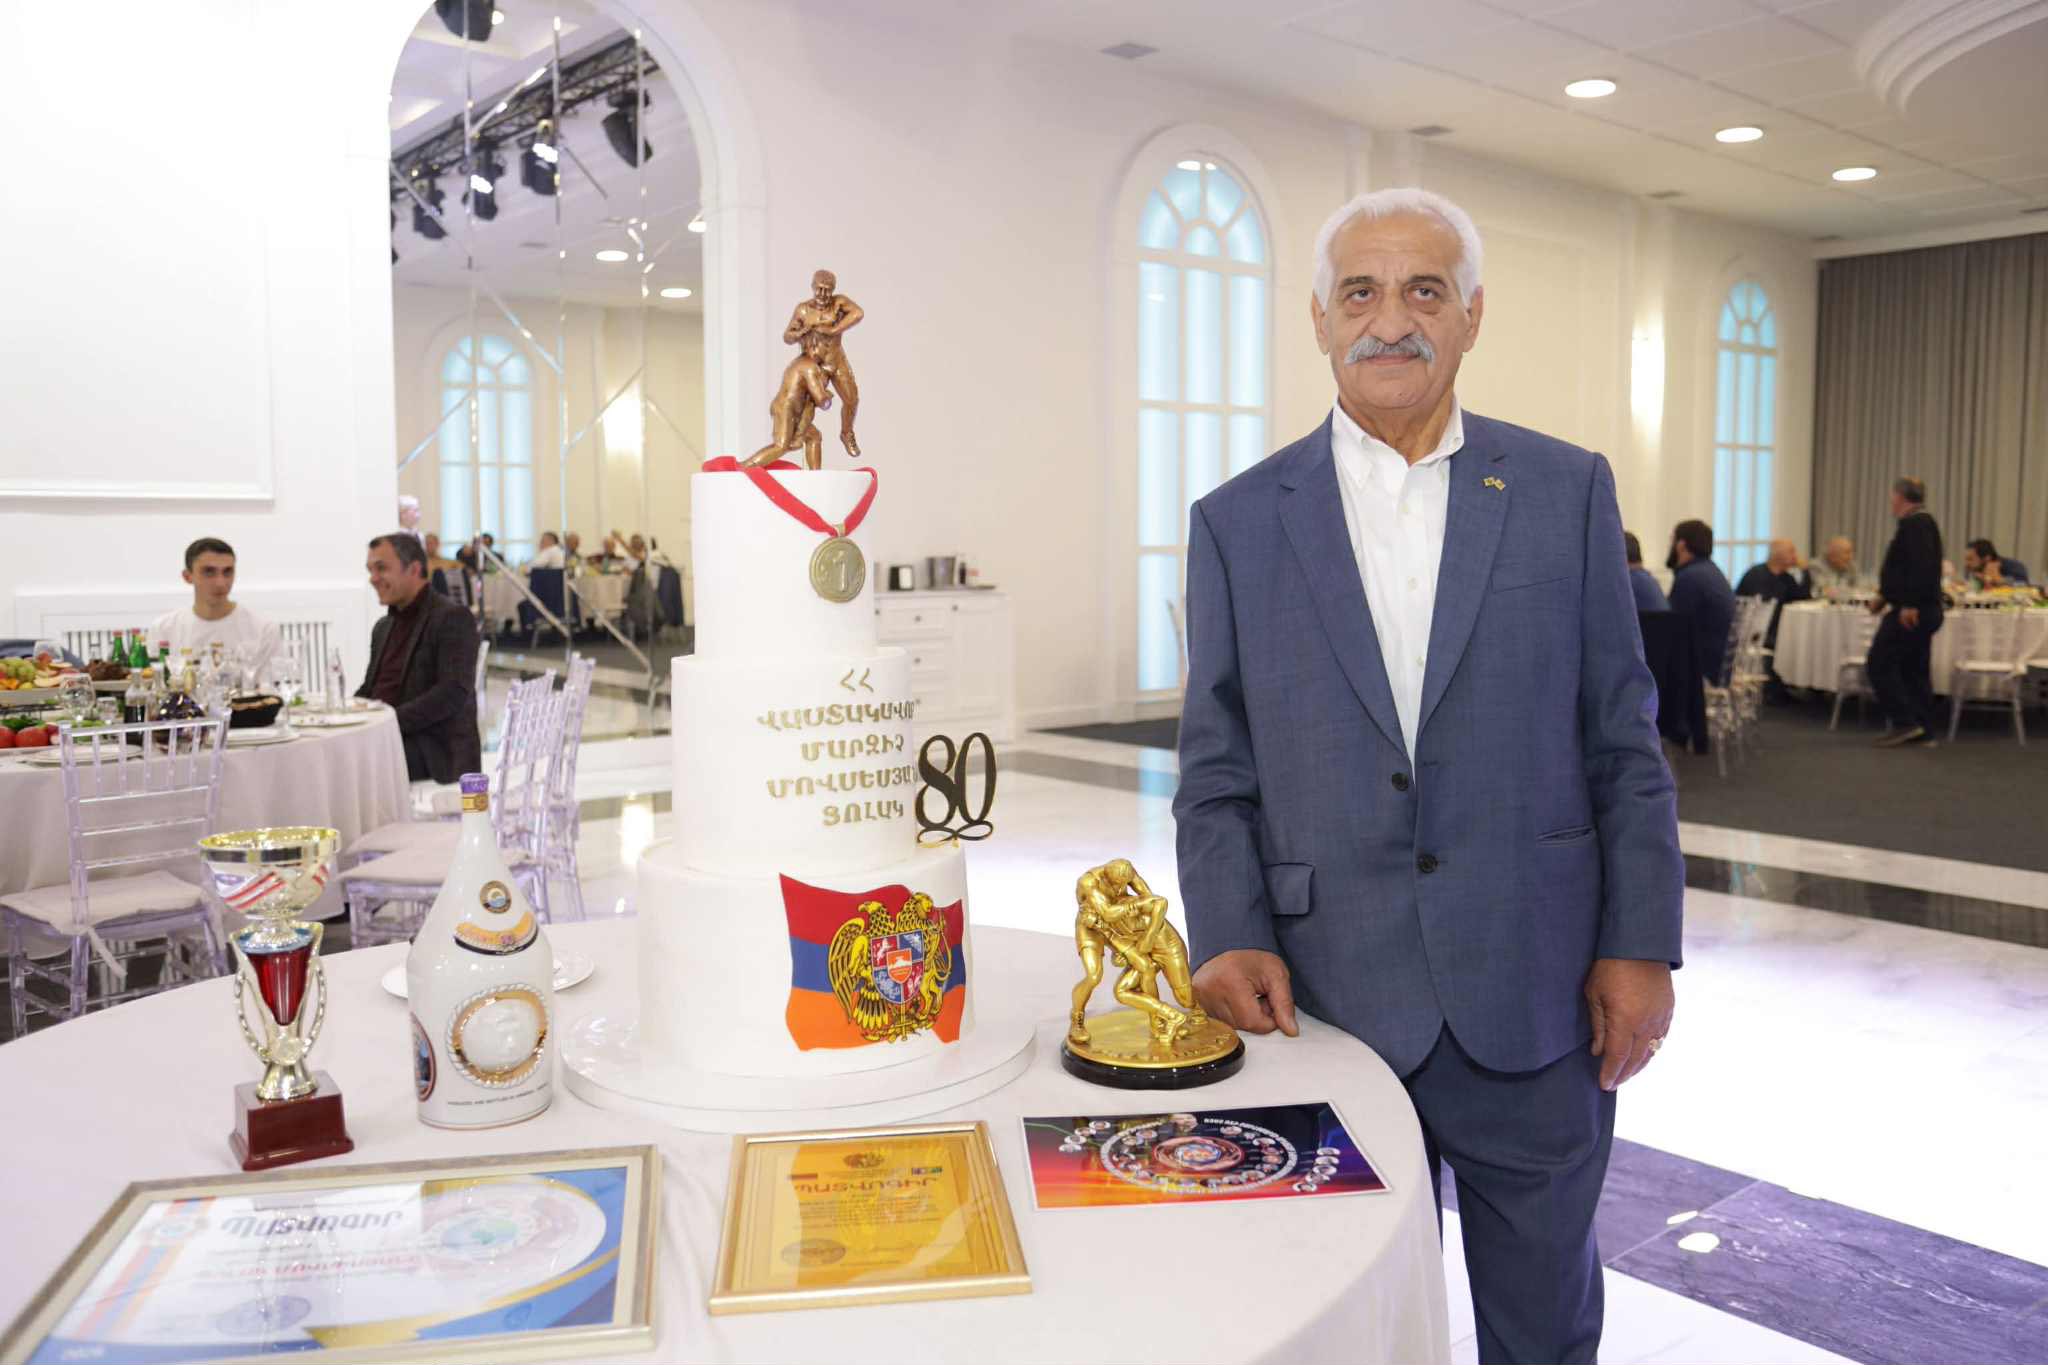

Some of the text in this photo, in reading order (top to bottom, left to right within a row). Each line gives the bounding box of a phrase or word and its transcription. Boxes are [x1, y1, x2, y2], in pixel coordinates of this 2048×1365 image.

[840, 667, 875, 693] ՀՀ
[801, 733, 905, 762] ՄԱՐԶԻՉ
[915, 732, 997, 828] 80
[822, 799, 904, 826] ՑՈԼԱԿ
